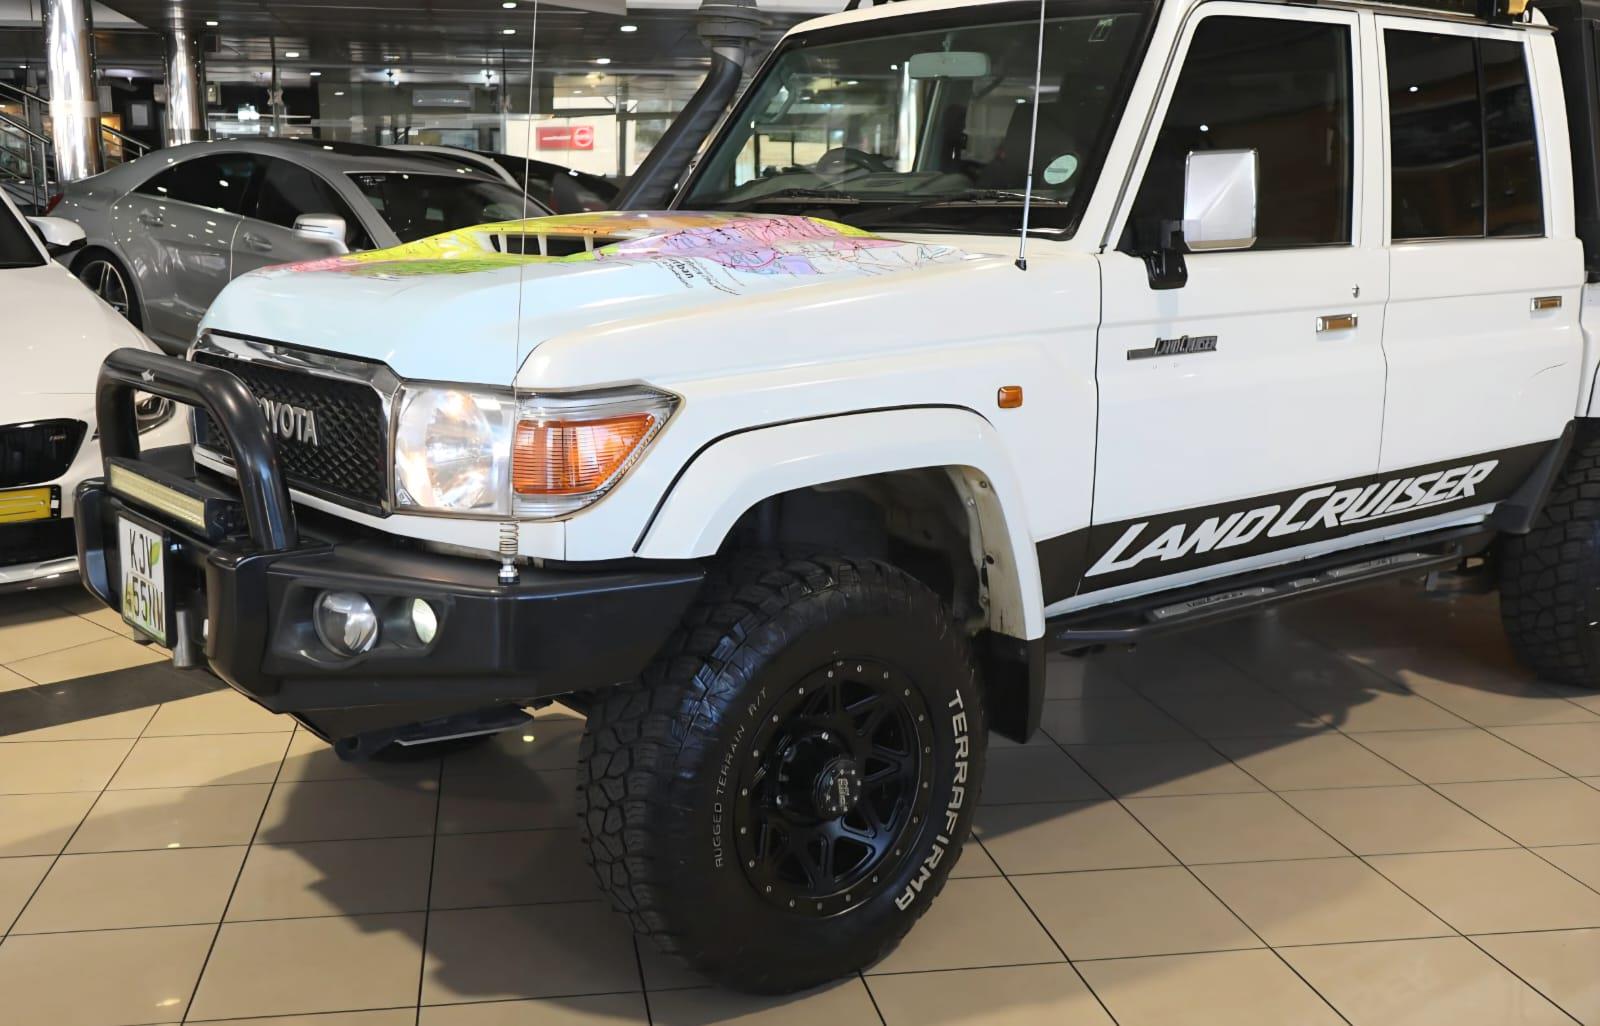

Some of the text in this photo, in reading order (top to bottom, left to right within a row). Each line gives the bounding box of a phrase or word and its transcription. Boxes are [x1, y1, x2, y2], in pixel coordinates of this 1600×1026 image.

[255, 396, 318, 446] OYOTA
[716, 725, 745, 796] TERRAIN
[895, 688, 969, 911] TERRAFIRMA
[713, 802, 724, 868] RUGGED
